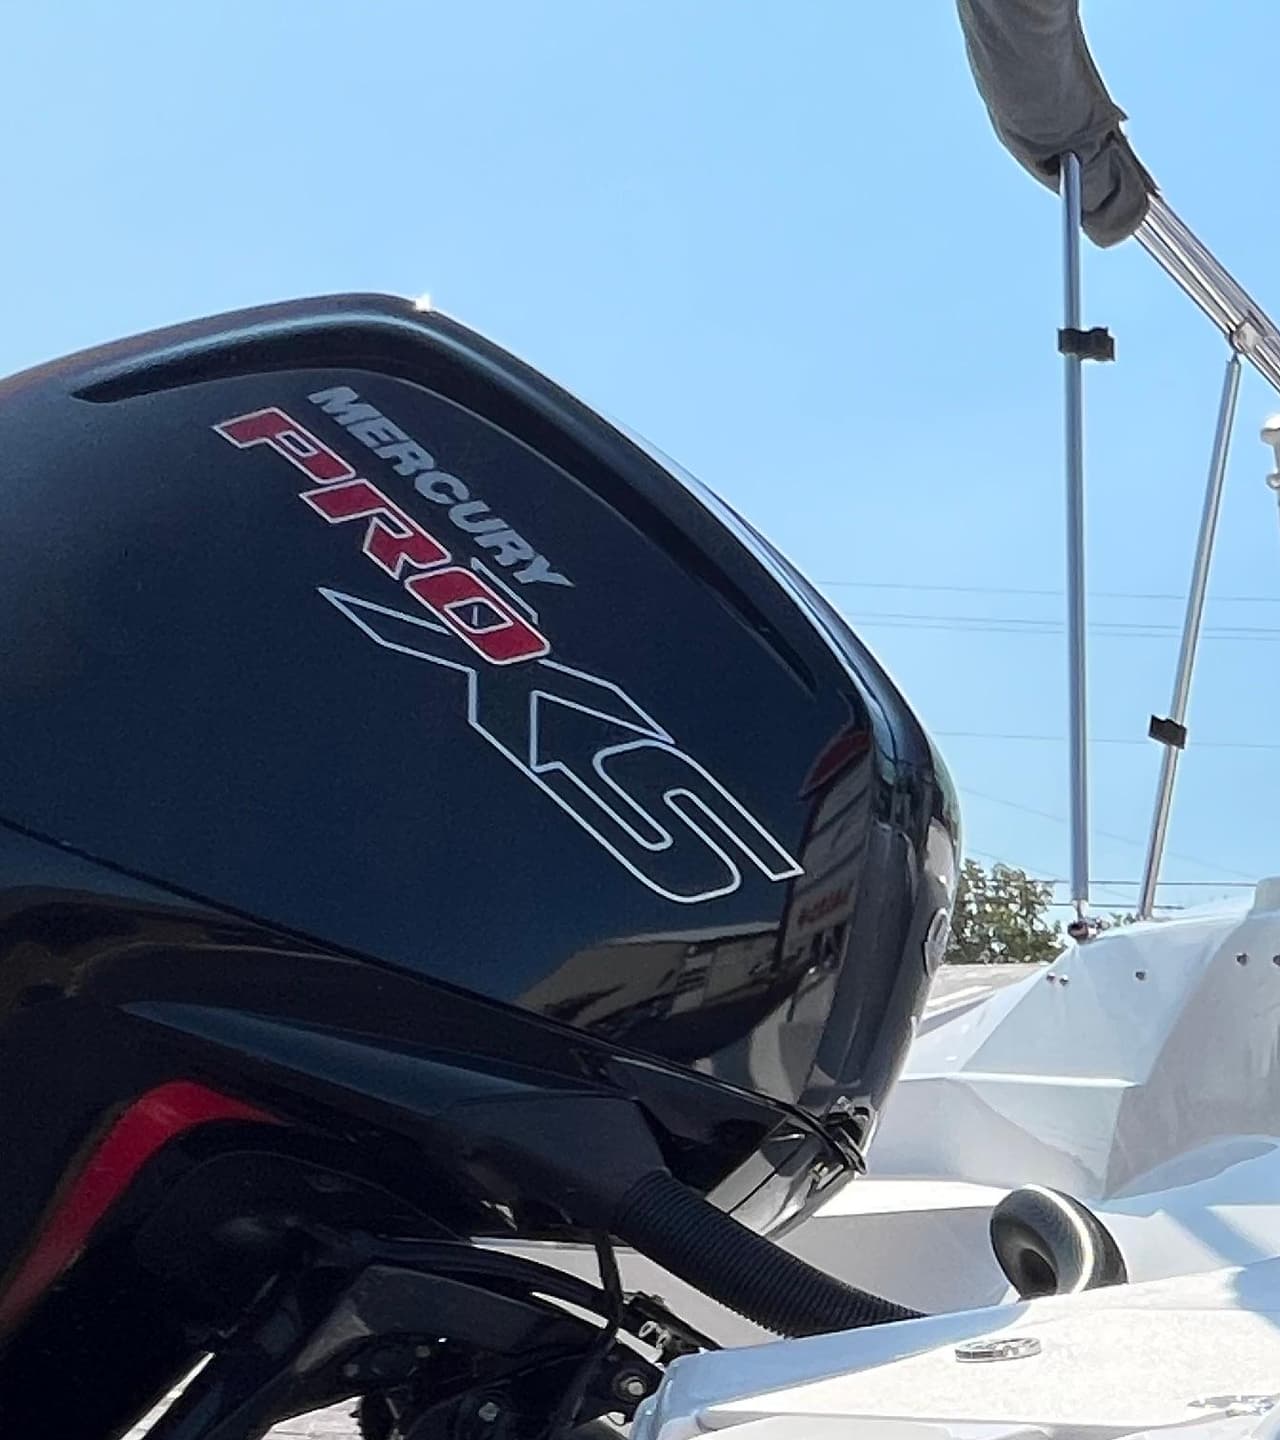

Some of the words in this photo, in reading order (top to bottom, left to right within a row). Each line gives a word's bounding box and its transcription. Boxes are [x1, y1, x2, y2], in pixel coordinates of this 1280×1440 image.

[212, 407, 550, 665] PRO
[308, 386, 575, 588] MERCURY
[317, 558, 804, 904] XS
